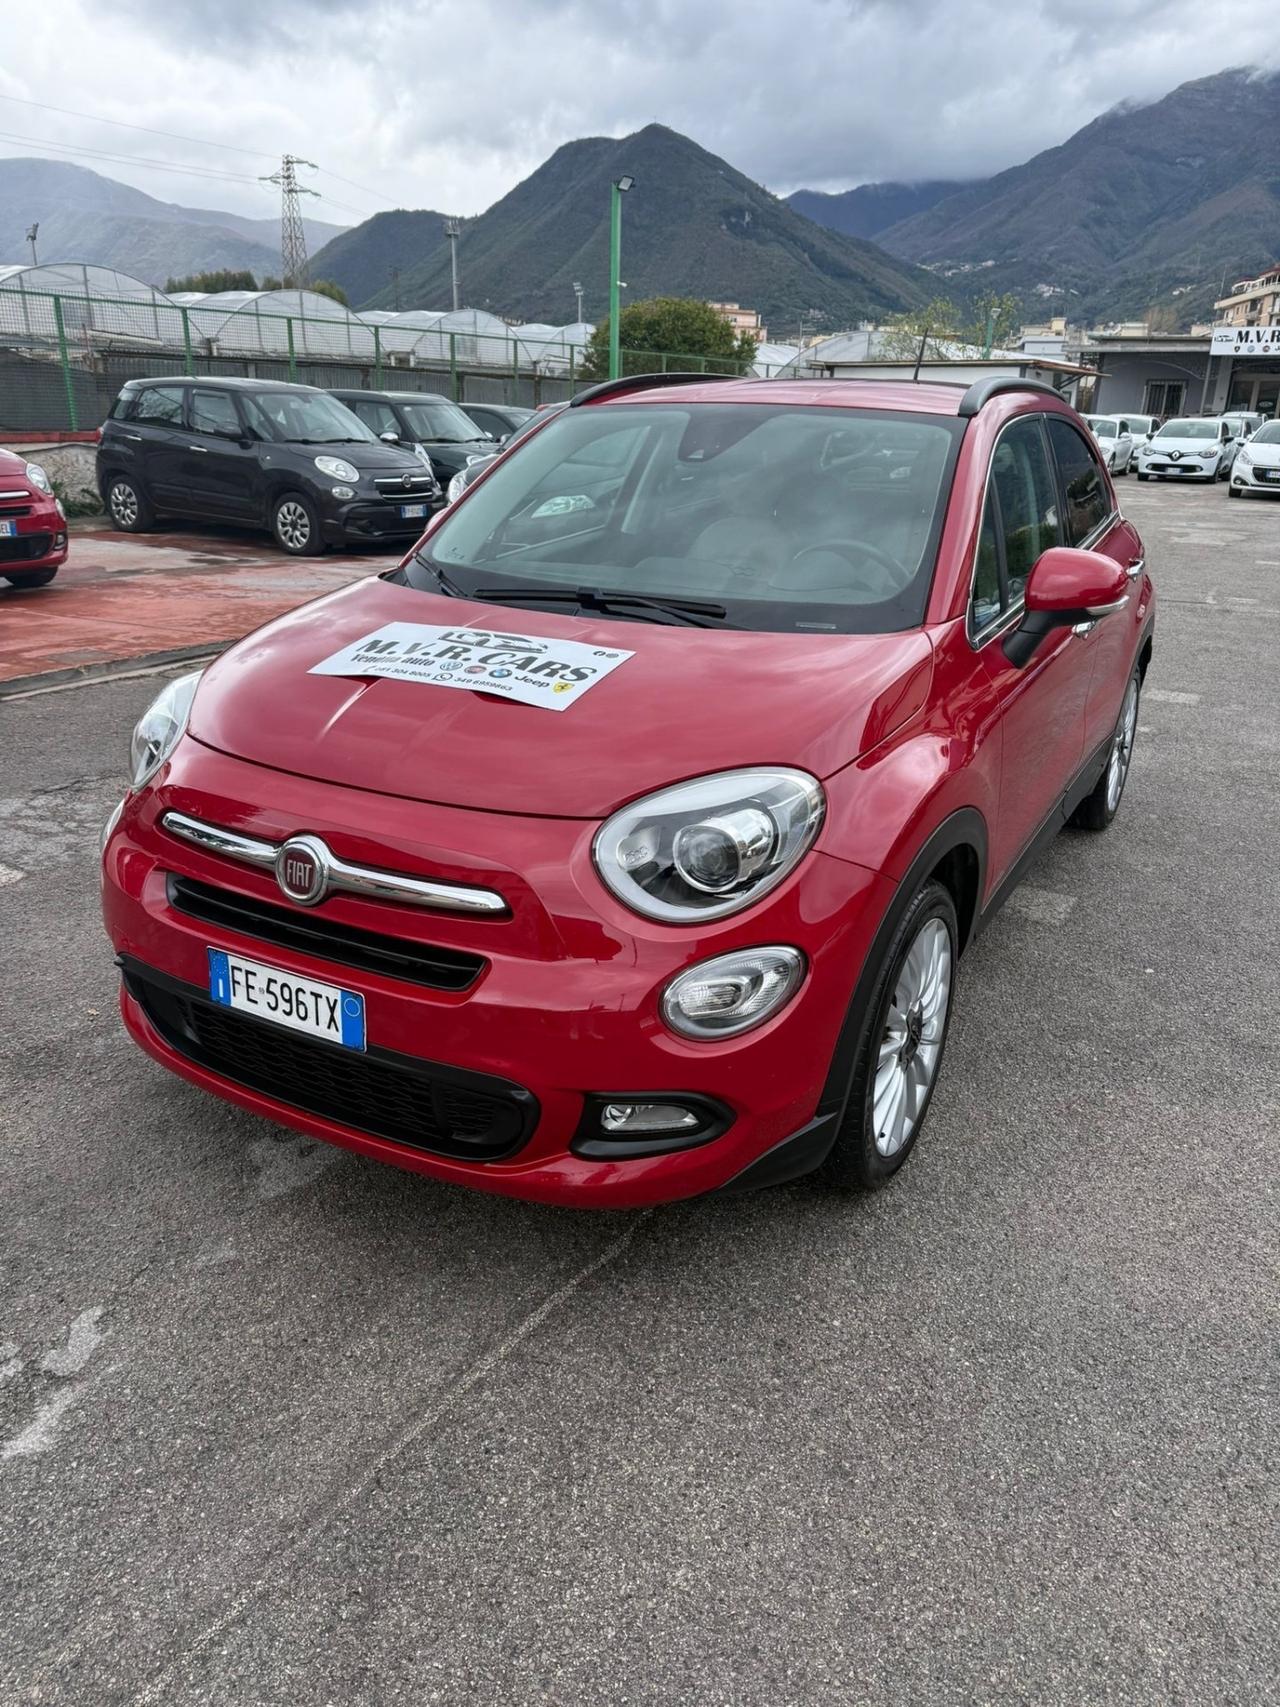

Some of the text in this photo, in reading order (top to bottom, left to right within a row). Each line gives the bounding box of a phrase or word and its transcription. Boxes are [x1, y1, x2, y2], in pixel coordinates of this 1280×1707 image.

[400, 656, 436, 667] auto
[514, 675, 550, 688] Jeep
[286, 859, 313, 888] FIAT
